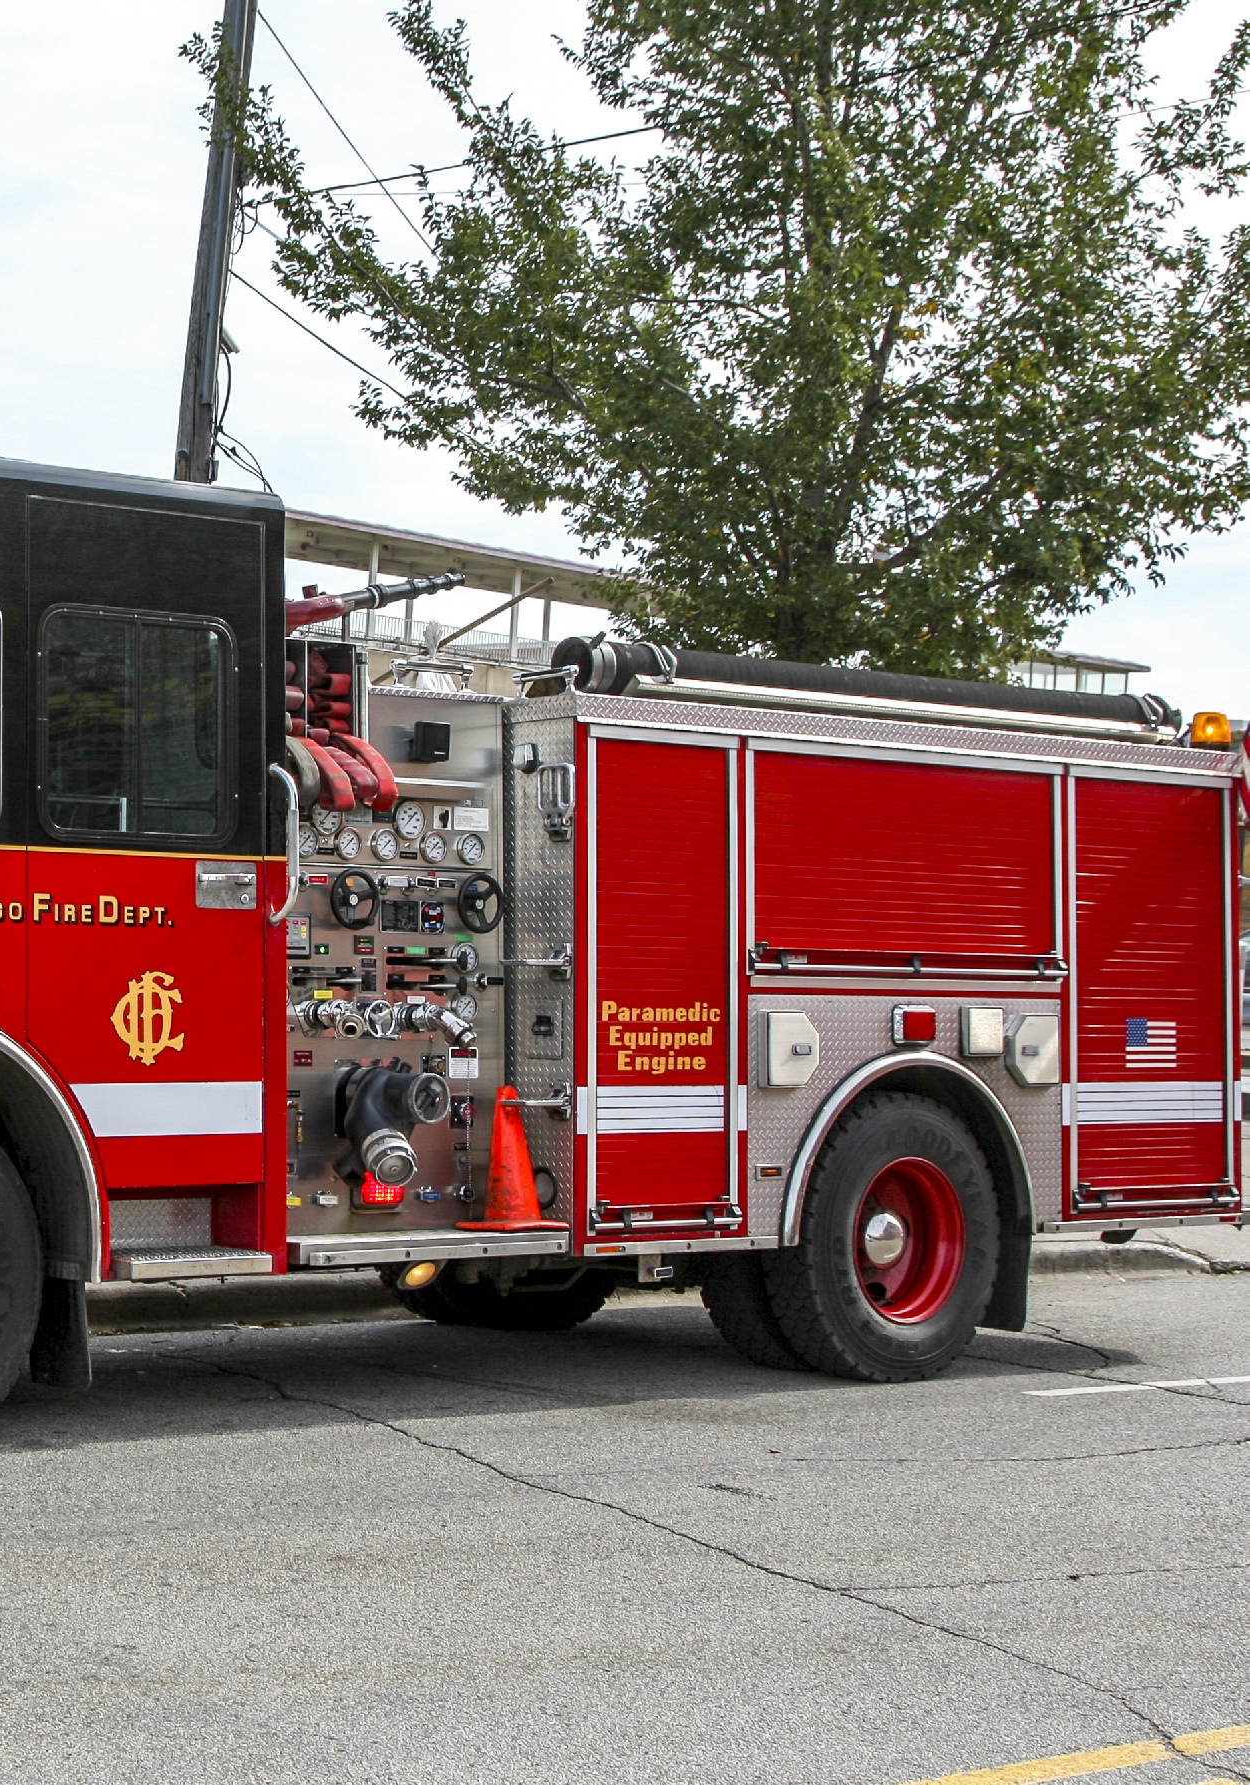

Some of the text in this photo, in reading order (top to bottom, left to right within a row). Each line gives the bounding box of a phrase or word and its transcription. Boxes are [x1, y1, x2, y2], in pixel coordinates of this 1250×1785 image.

[32, 892, 93, 923] FIRE
[601, 1000, 721, 1022] Paramedic
[609, 1025, 713, 1050] Equipped
[617, 1050, 707, 1075] Engine
